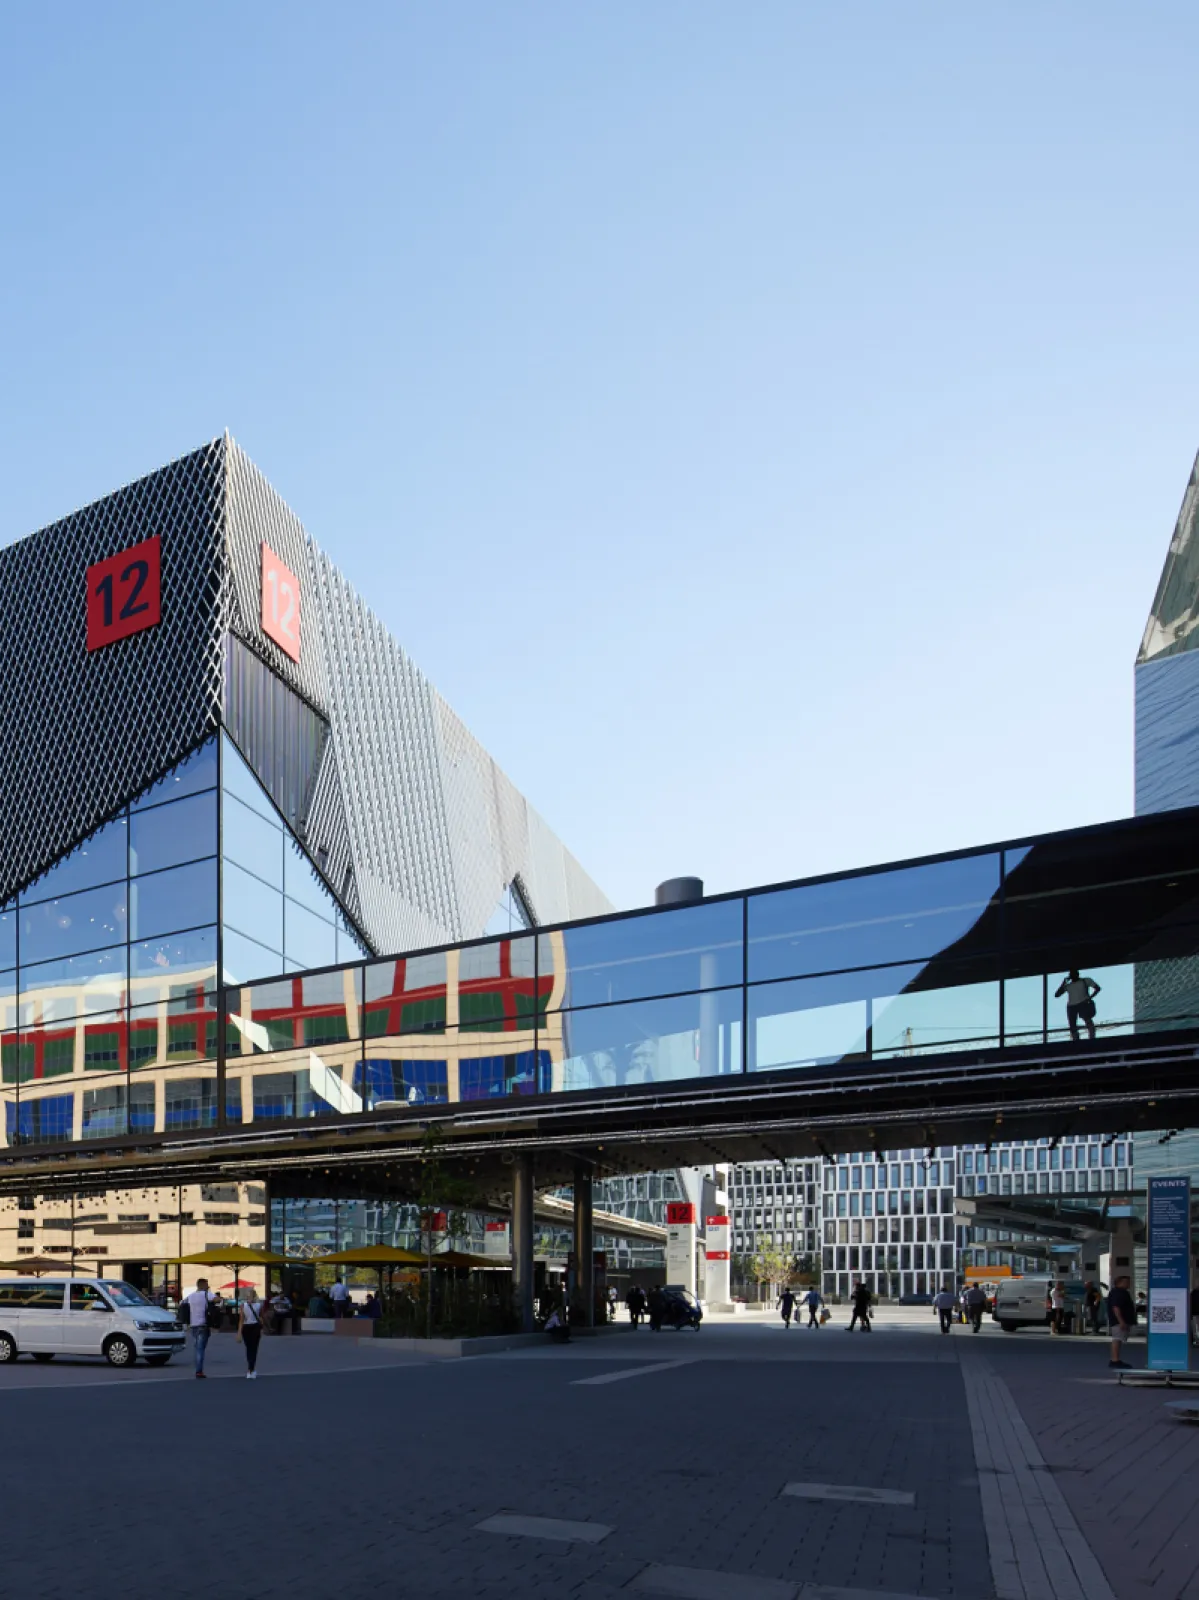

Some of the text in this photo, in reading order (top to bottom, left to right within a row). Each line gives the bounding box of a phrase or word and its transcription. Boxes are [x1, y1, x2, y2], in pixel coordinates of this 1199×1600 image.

[95, 559, 149, 627] 12
[267, 568, 296, 641] 12
[1152, 1180, 1186, 1188] EVENTS
[671, 1207, 688, 1220] 12
